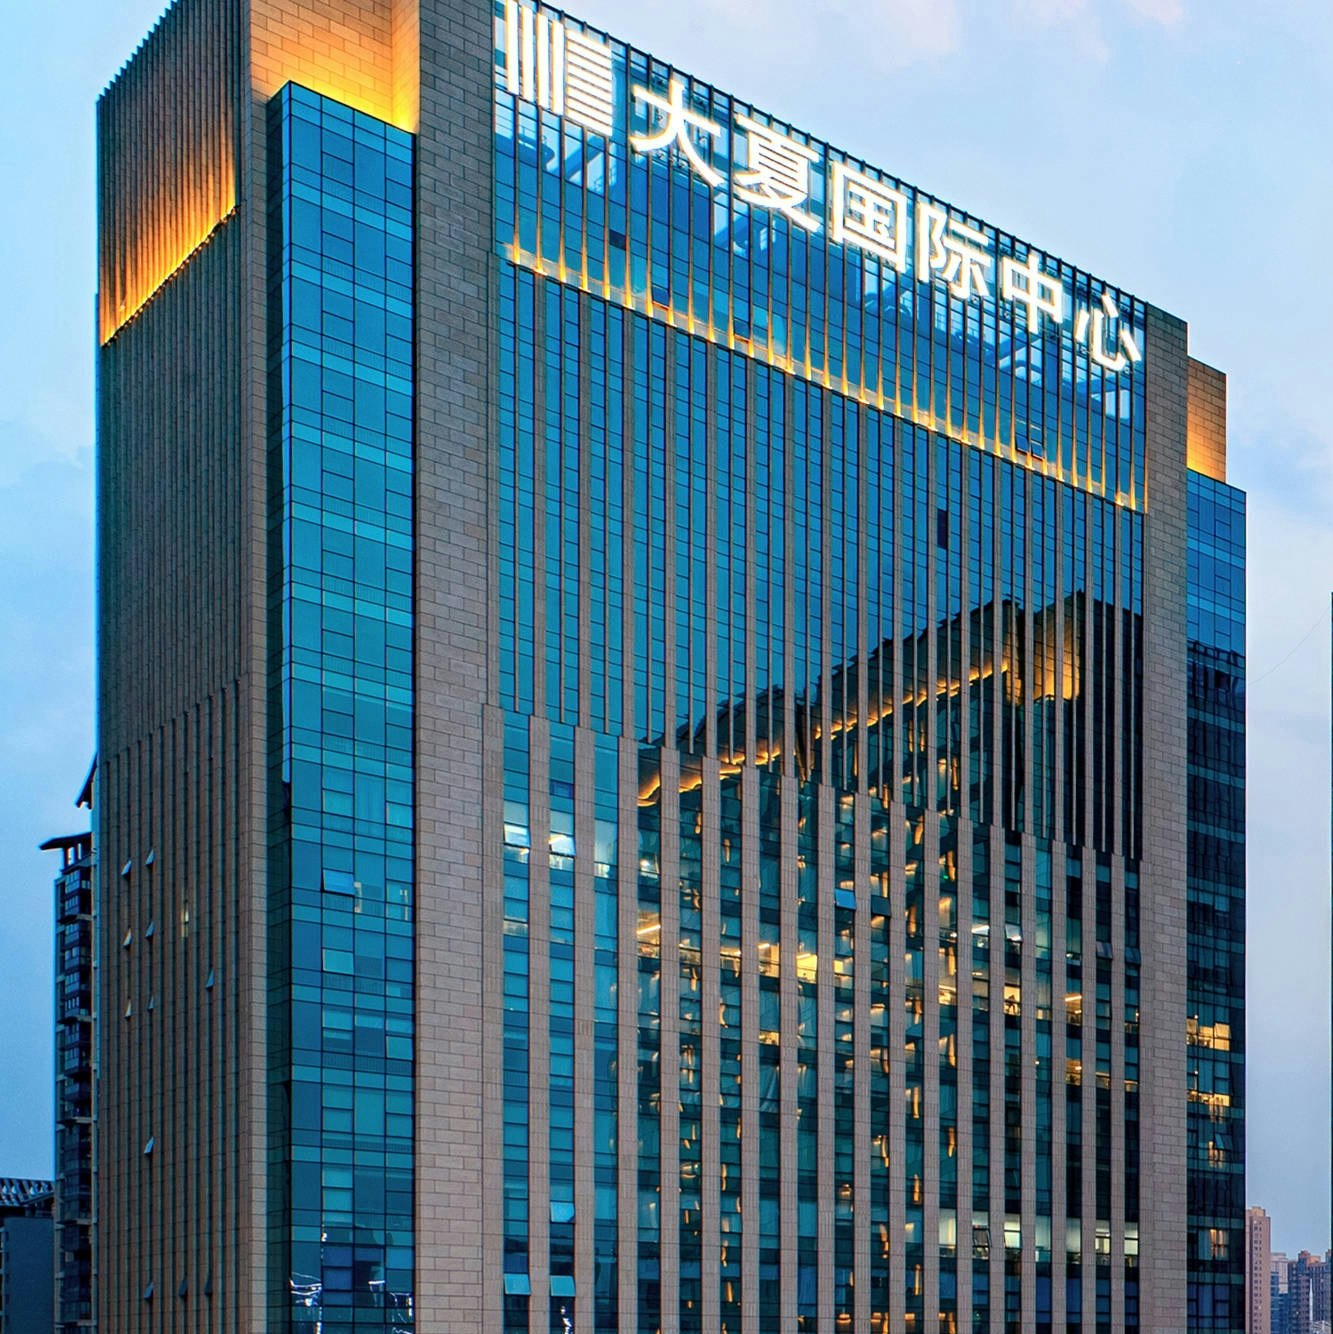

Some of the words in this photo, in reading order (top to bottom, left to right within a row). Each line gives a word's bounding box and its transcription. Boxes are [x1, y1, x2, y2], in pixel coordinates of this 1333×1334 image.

[629, 78, 1141, 373] 大夏国际中心
